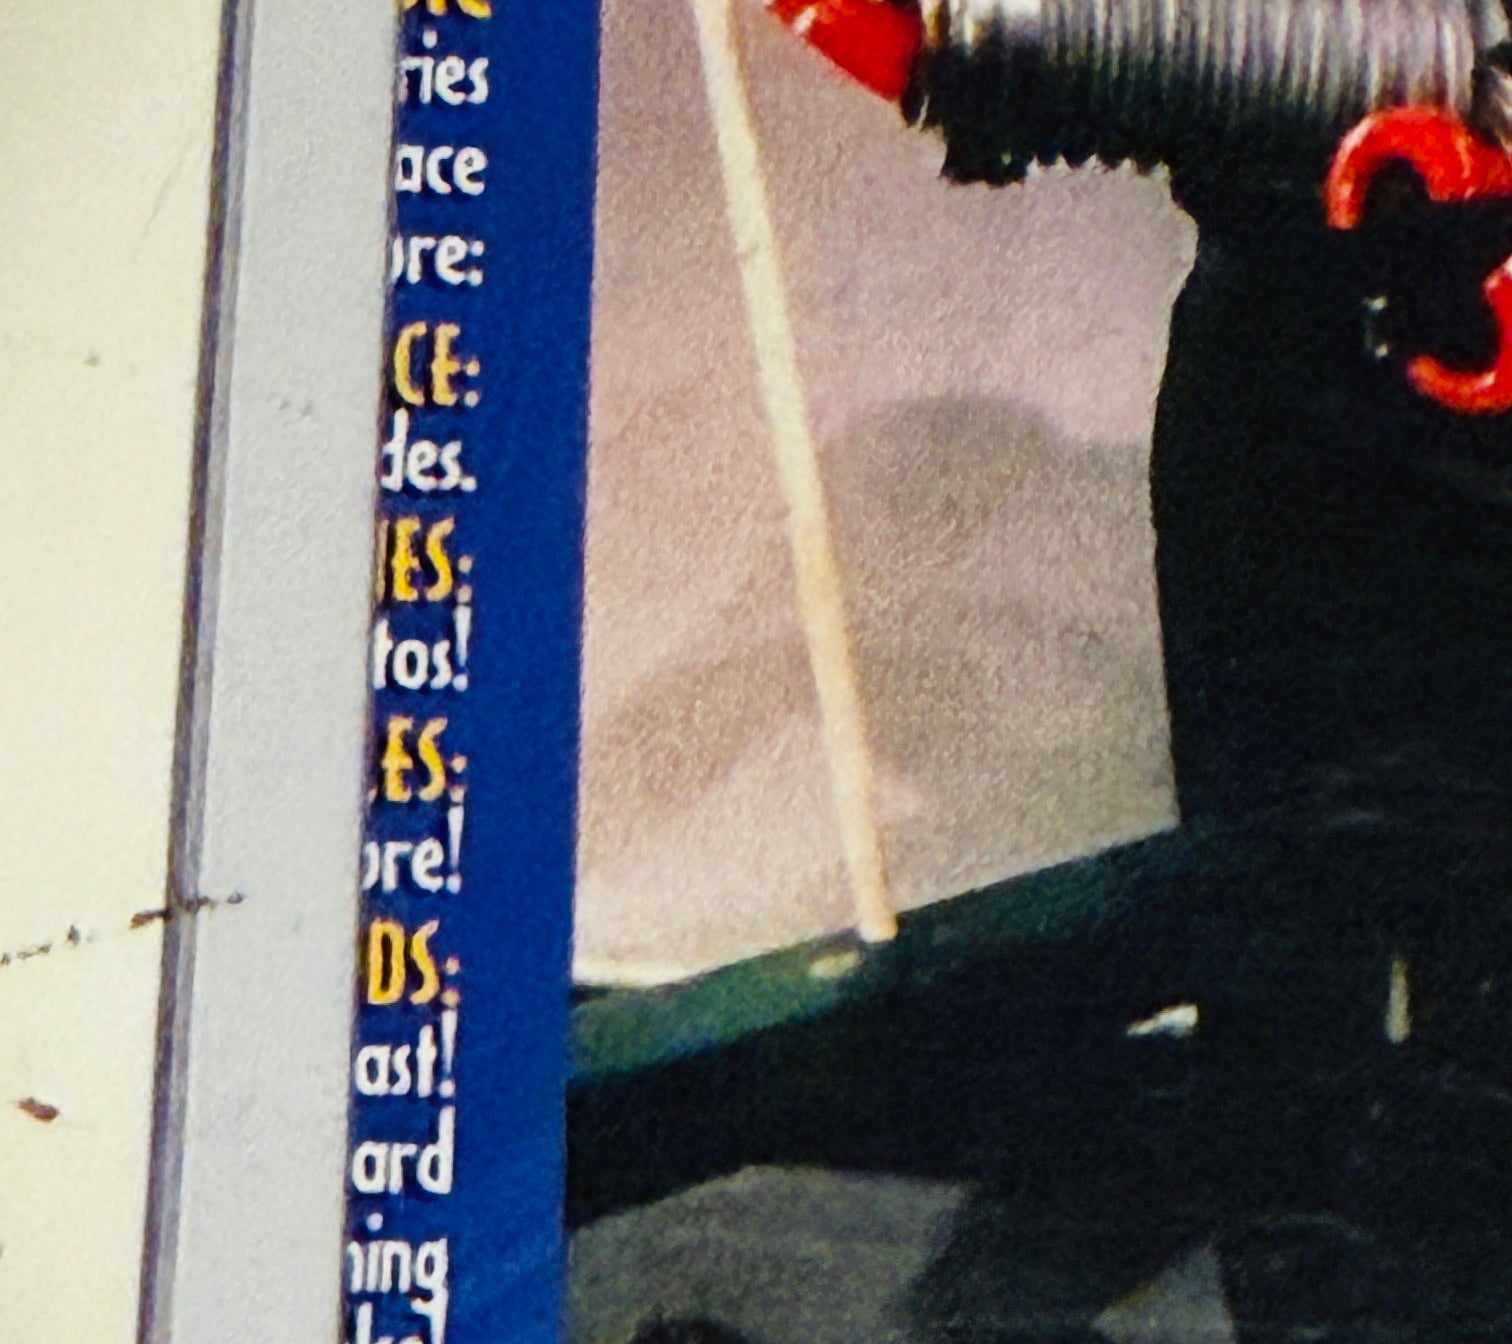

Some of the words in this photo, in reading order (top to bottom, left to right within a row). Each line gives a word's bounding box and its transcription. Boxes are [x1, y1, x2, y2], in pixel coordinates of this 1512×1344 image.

[396, 145, 487, 195] ace
[394, 320, 479, 405] CE:
[366, 715, 467, 802] ES:
[367, 917, 460, 1008] DS:
[355, 1009, 457, 1097] ast!
[352, 1105, 456, 1194] ard
